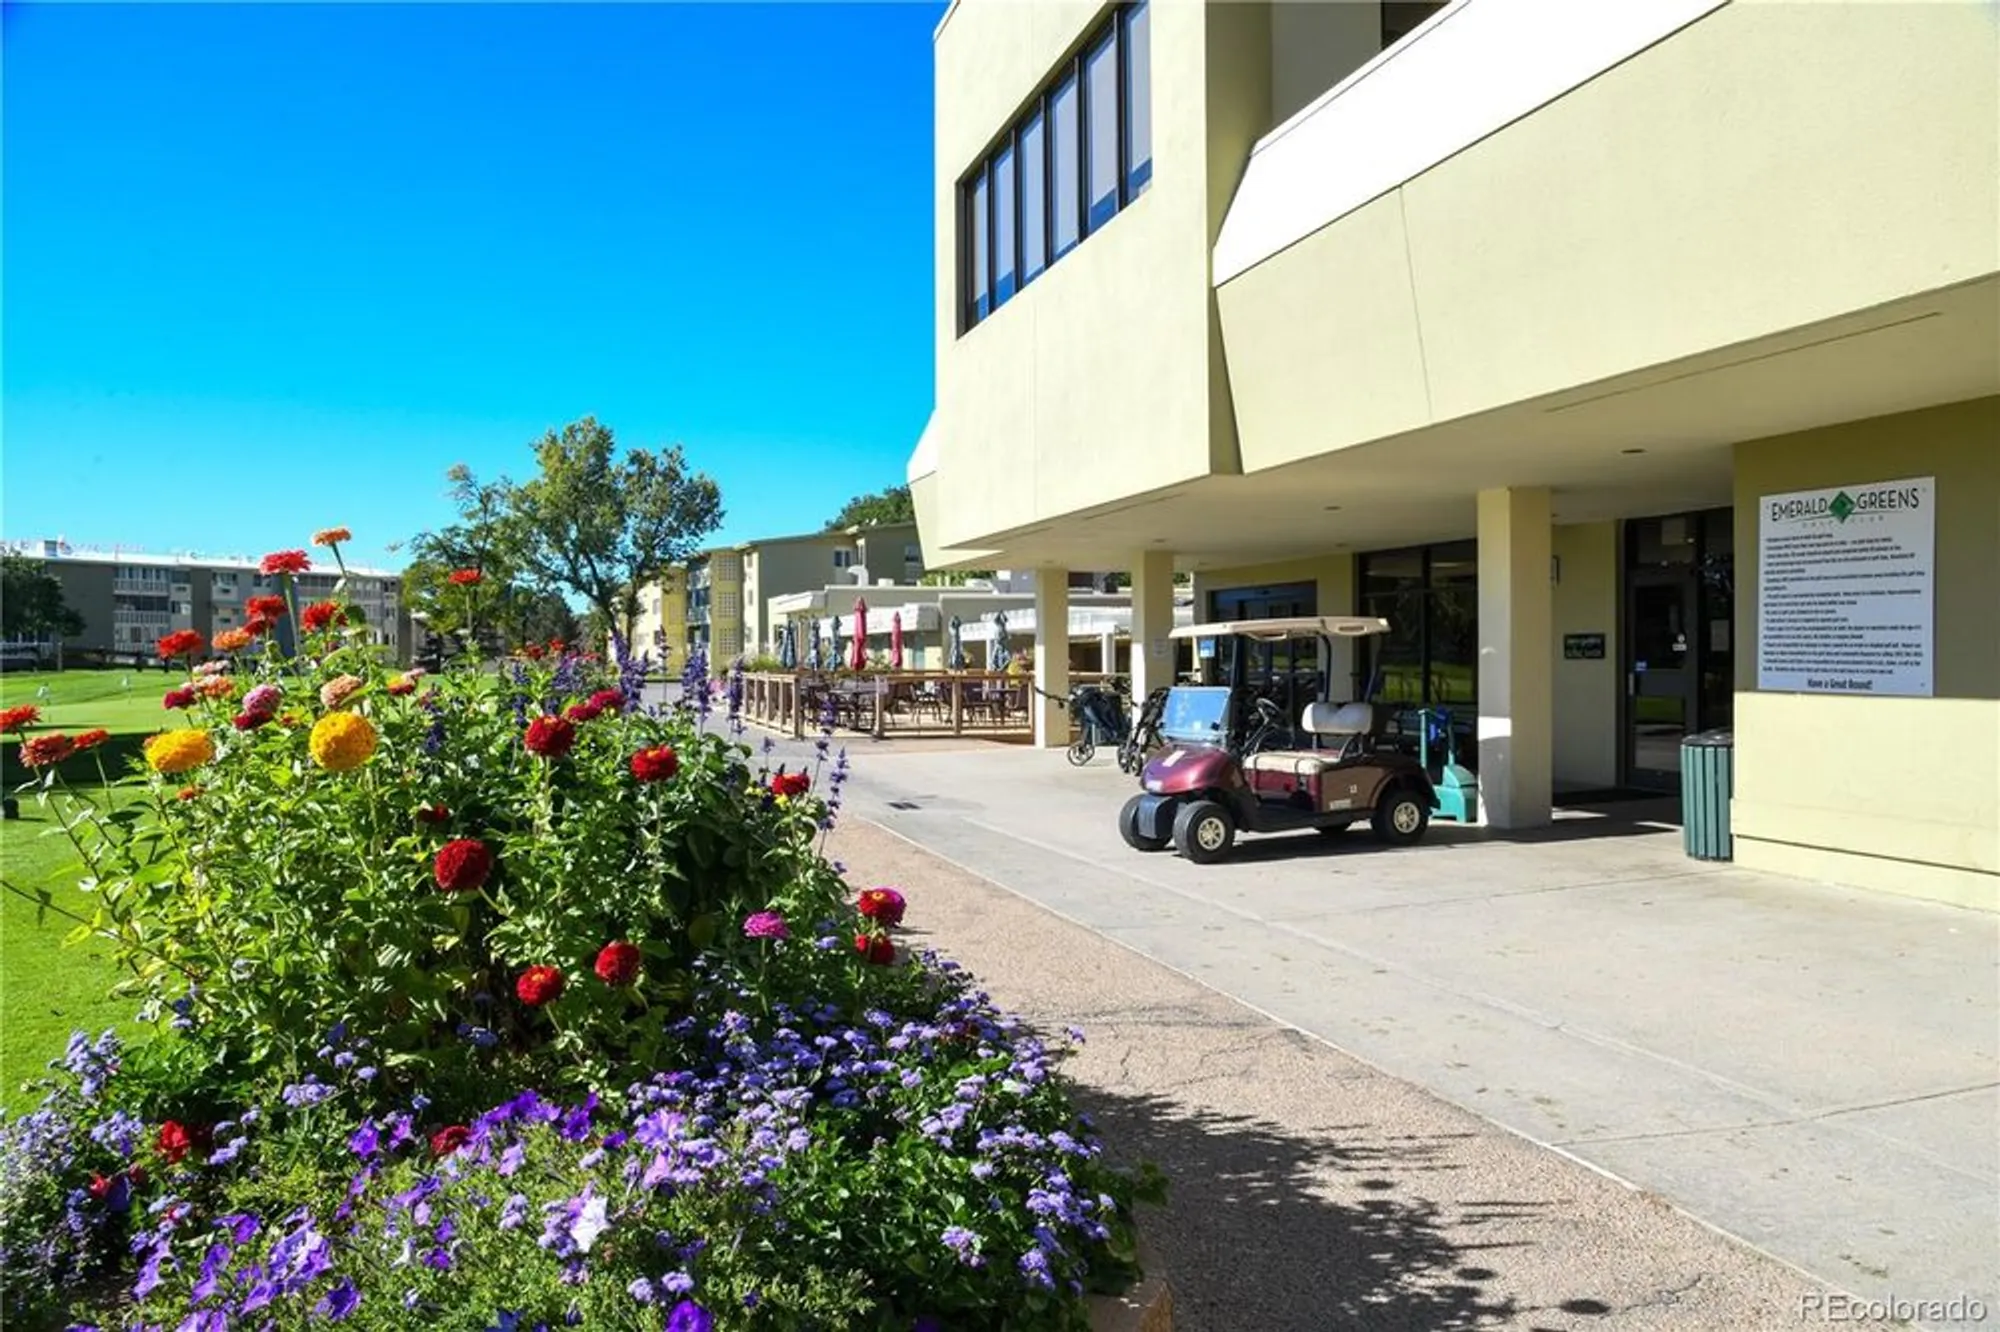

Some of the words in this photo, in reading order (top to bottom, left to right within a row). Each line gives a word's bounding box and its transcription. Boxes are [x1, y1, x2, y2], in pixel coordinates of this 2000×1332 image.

[1771, 498, 1828, 521] EMERALD
[1856, 487, 1920, 509] GREENS
[1807, 678, 1823, 688] Have
[1829, 678, 1847, 689] Great
